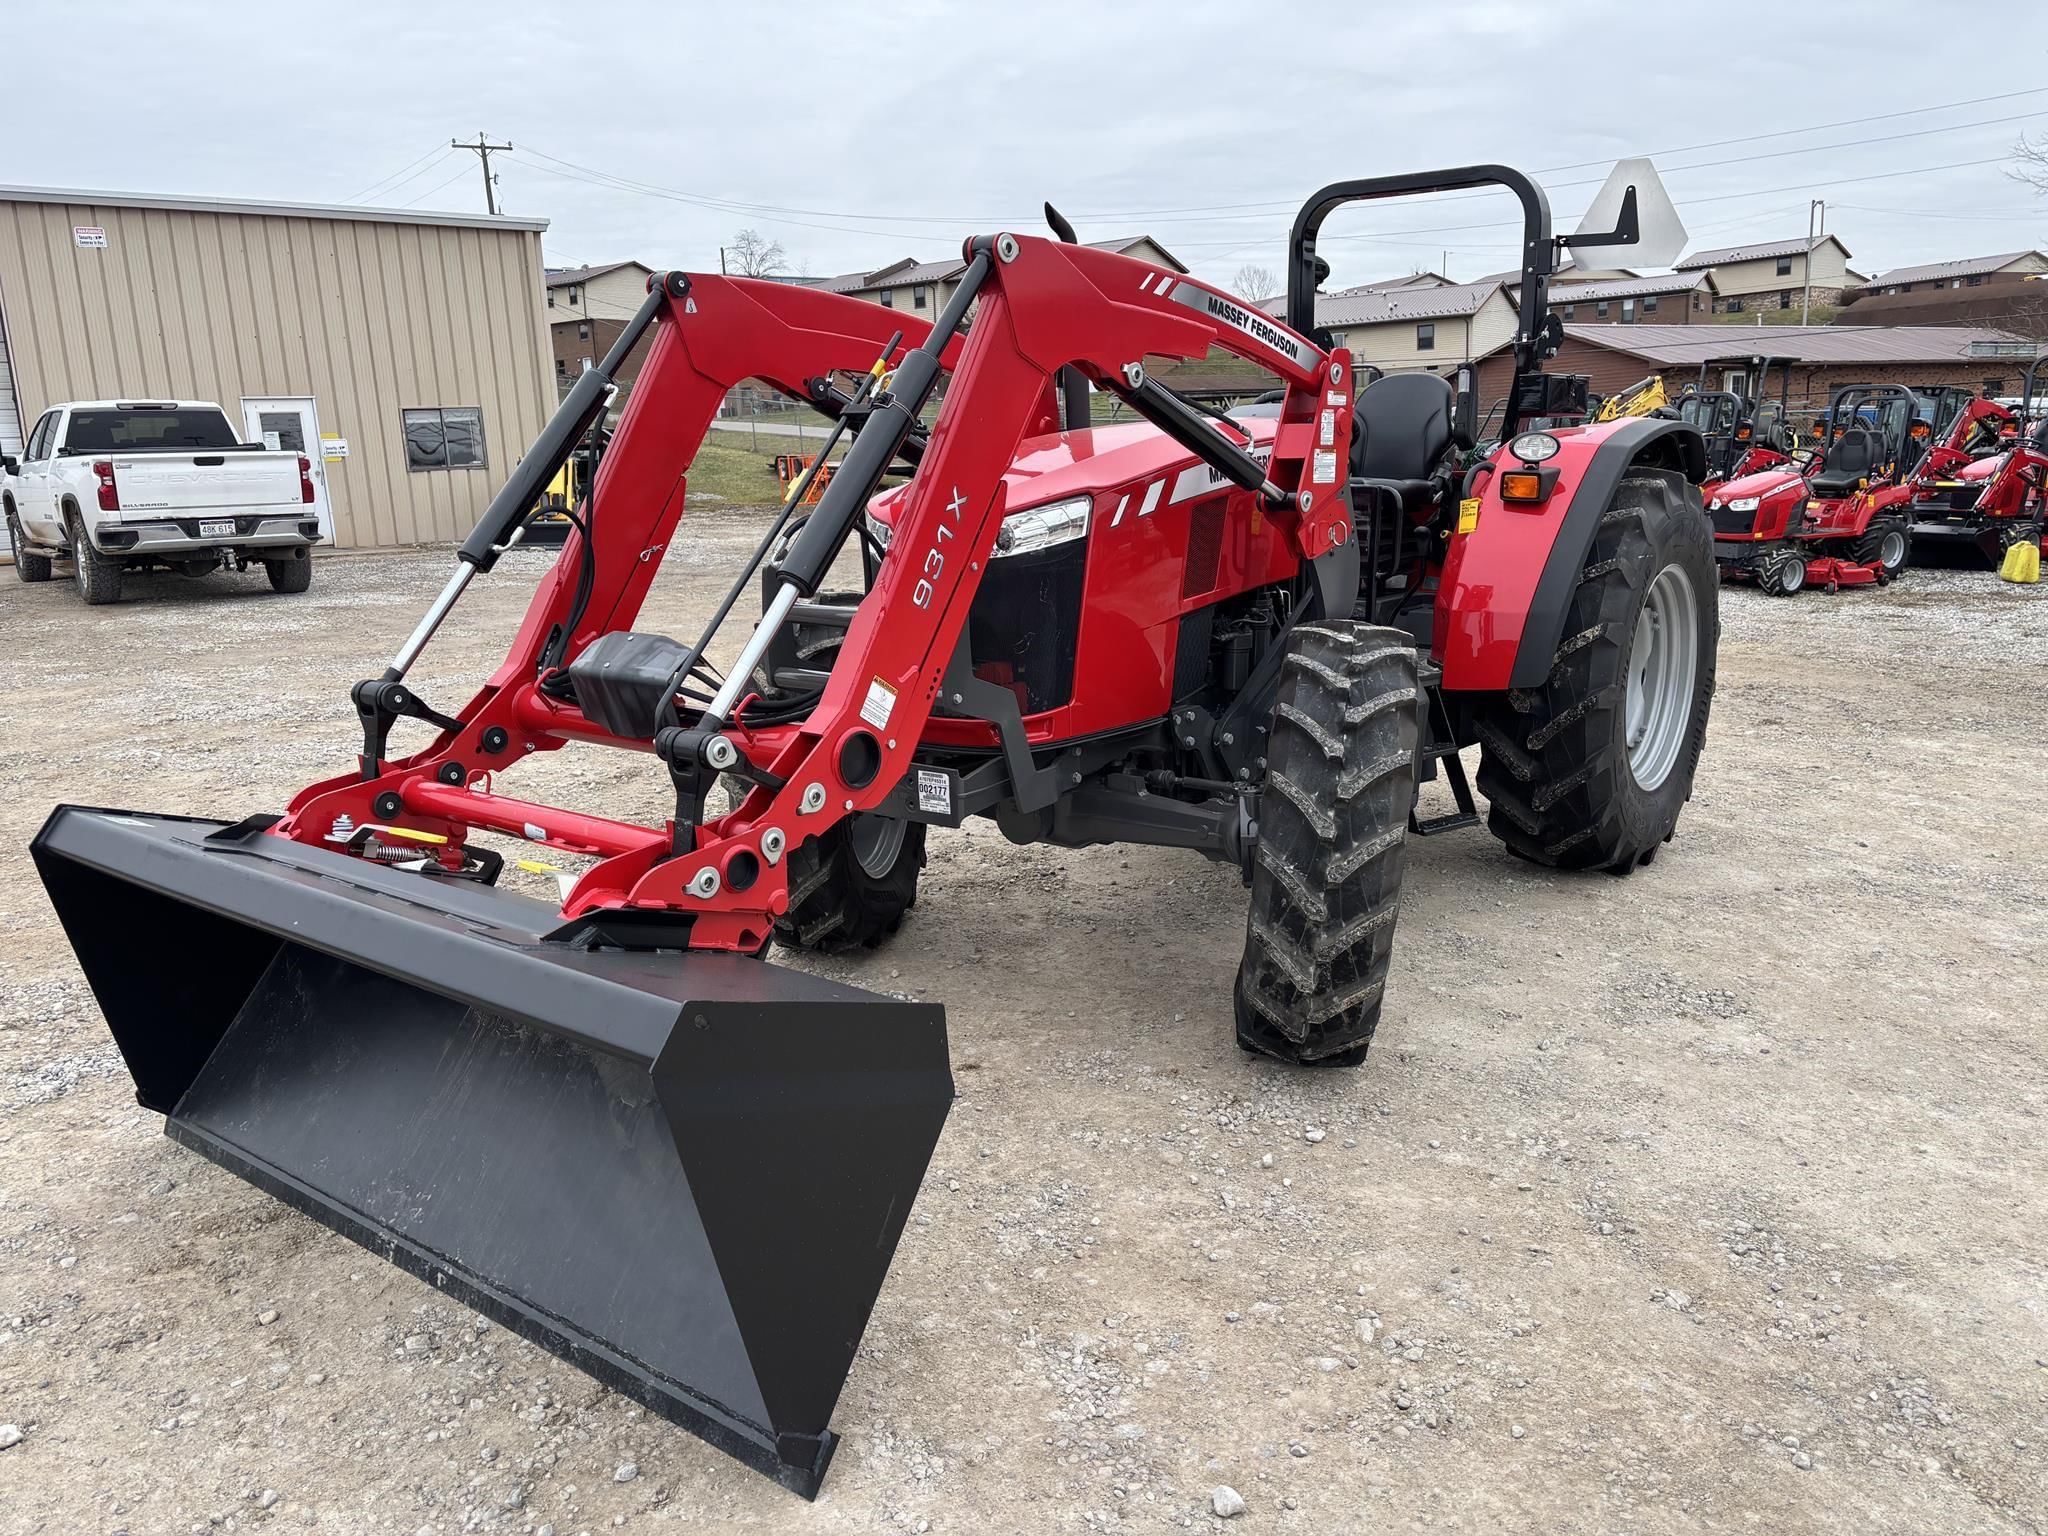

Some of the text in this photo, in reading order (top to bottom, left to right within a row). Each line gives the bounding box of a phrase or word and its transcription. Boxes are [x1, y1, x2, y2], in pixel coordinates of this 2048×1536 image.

[1208, 297, 1298, 359] MASSEY FERGUSON
[128, 471, 288, 485] CHEVROLET
[218, 524, 234, 533] 615
[919, 783, 947, 796] 002177
